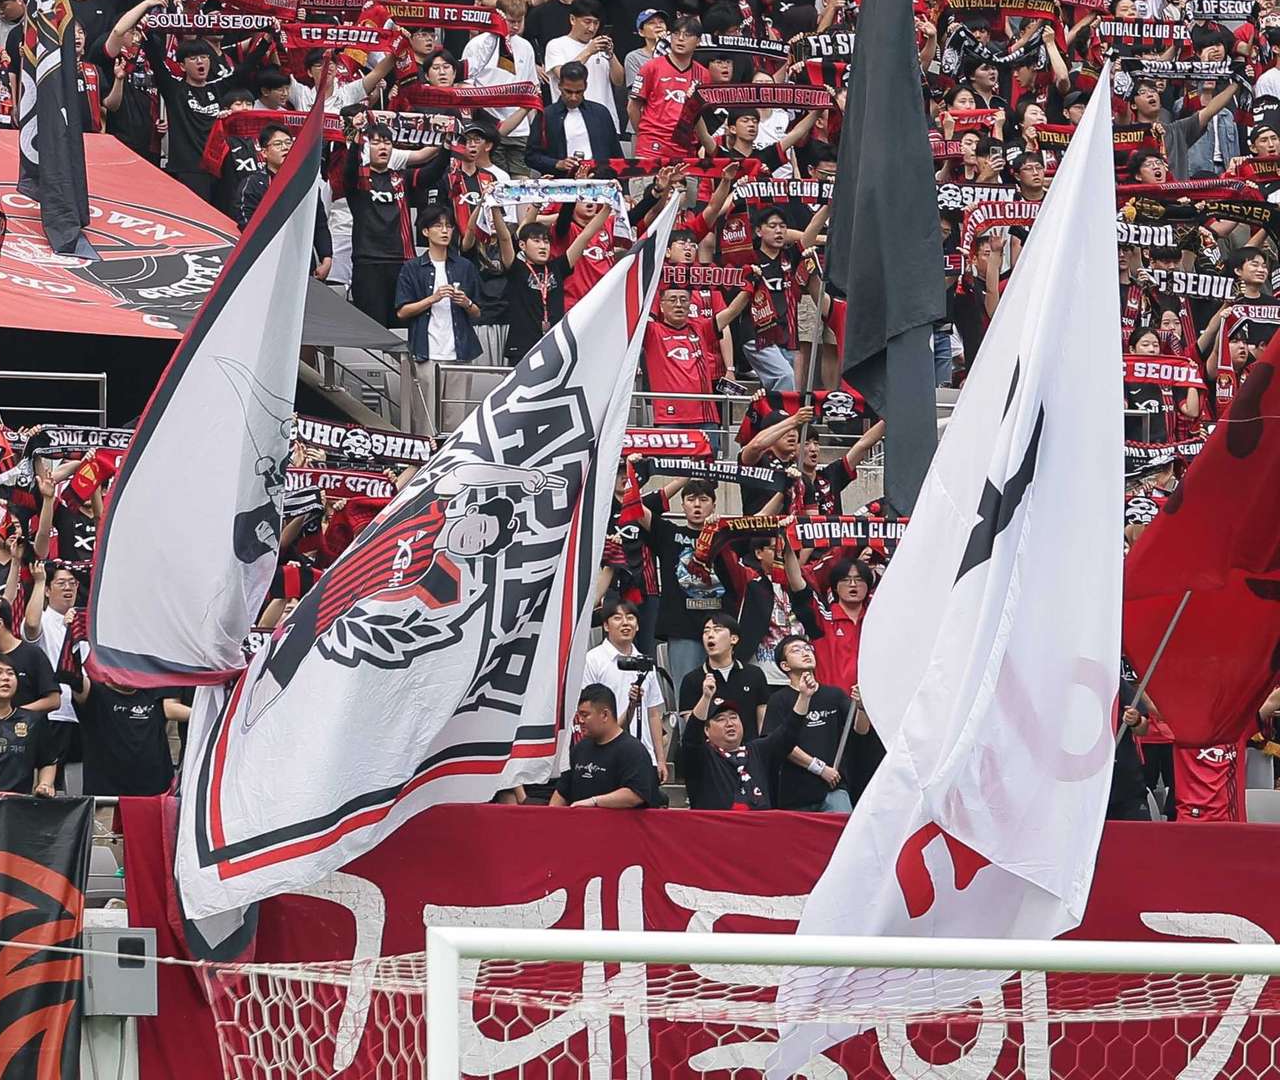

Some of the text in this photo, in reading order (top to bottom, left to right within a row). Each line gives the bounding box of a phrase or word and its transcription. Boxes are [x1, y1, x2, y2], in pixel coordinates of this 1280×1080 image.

[429, 7, 492, 24] IN FC SEOUL
[1142, 23, 1170, 39] CLUB
[2, 192, 184, 241] COWN
[721, 228, 747, 242] Seoul
[1173, 272, 1235, 300] SEOUL
[372, 435, 430, 461] SHIN
